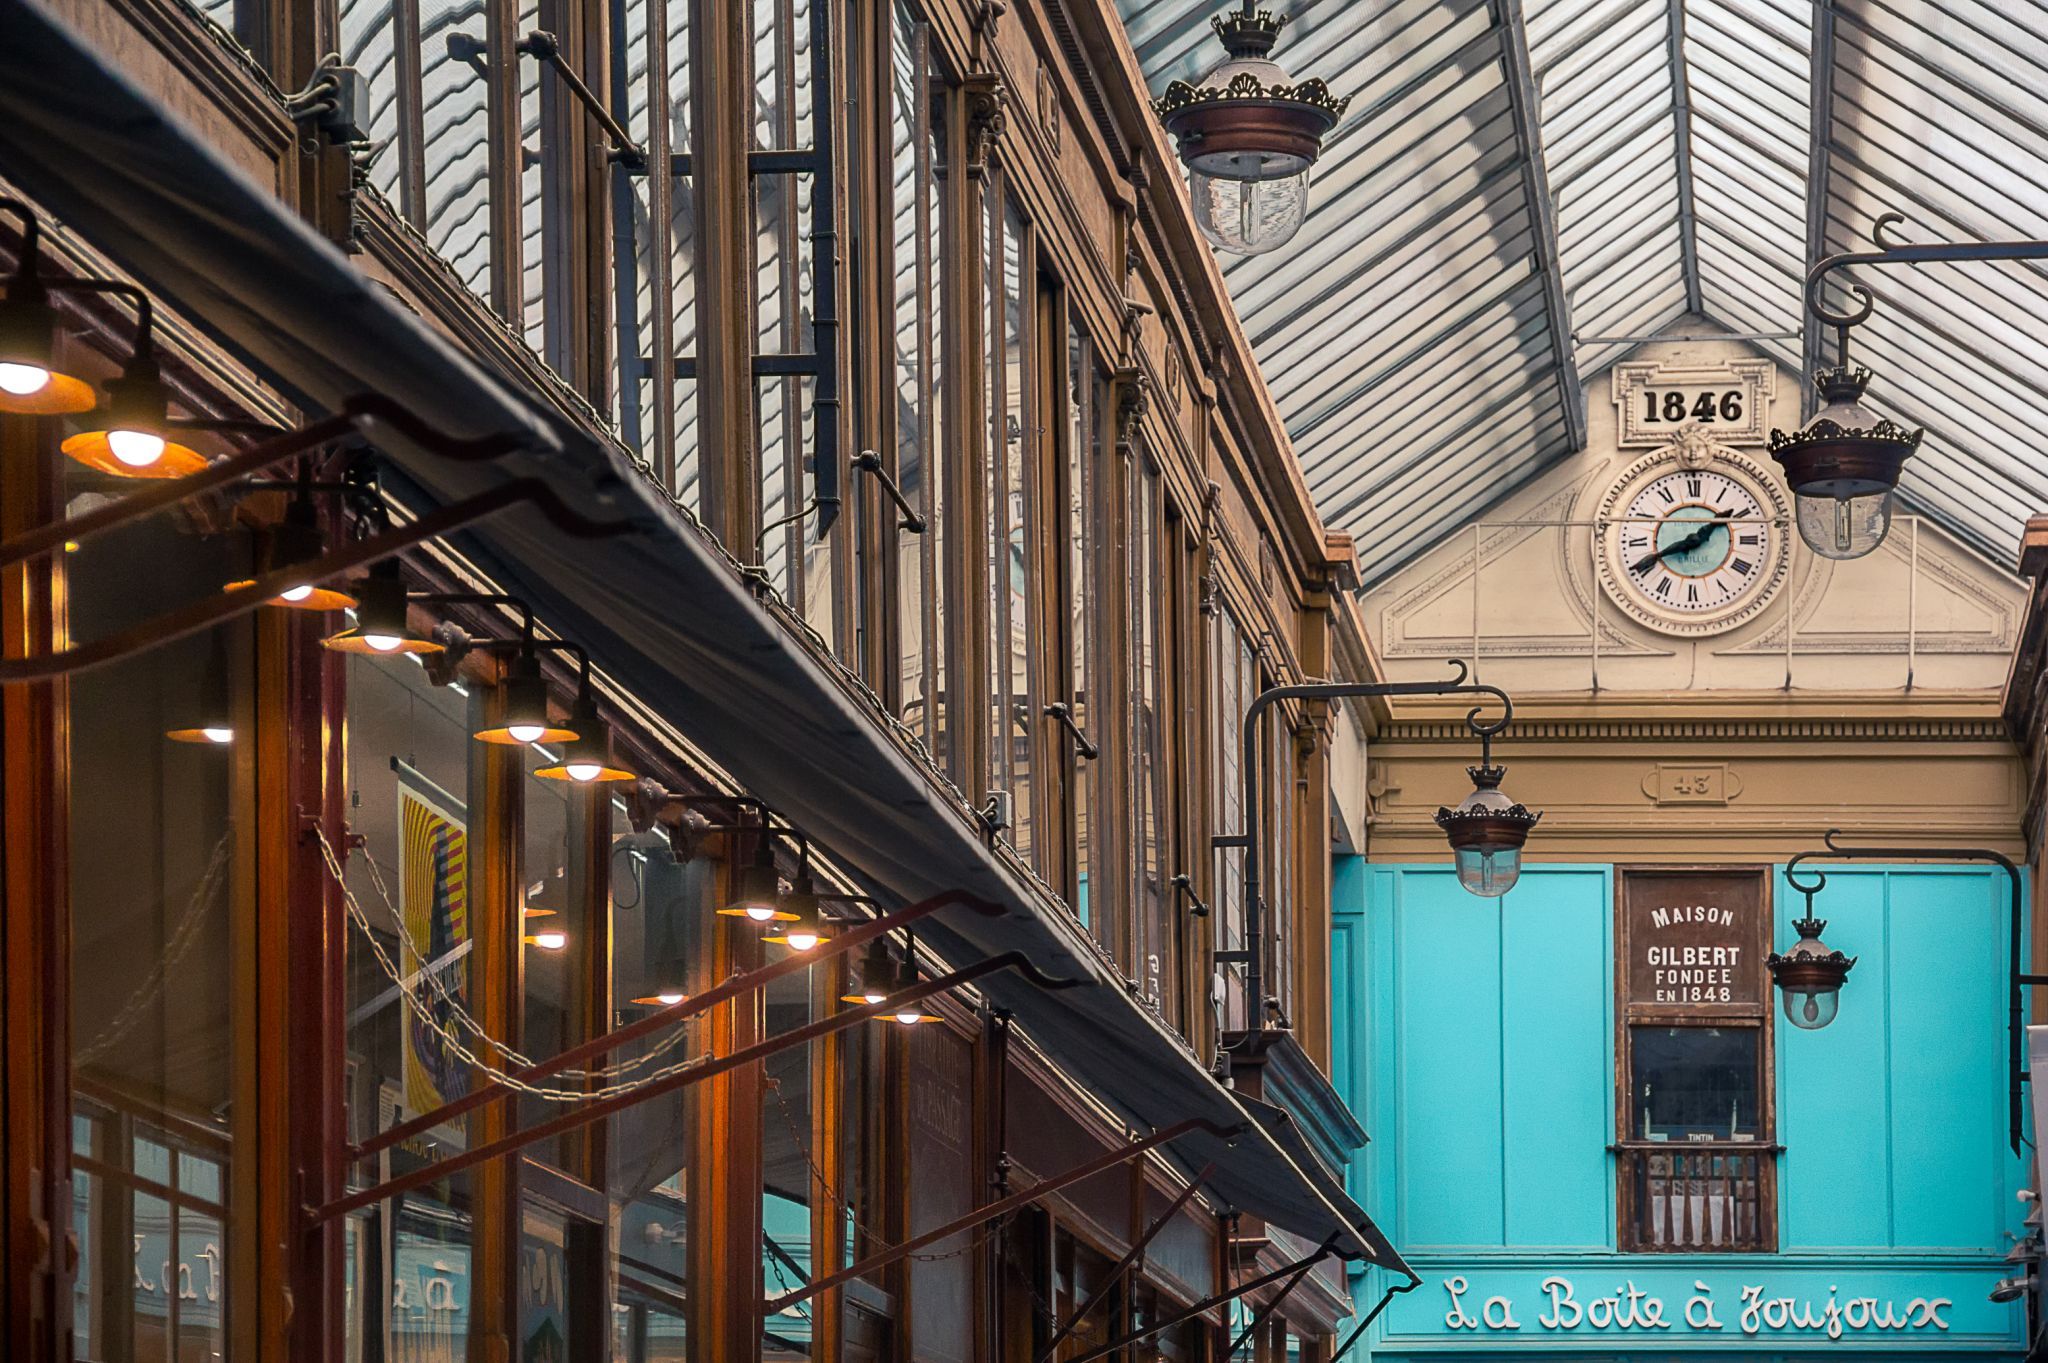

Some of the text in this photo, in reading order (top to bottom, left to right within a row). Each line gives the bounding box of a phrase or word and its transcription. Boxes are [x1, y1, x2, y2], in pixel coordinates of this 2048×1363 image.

[1643, 390, 1744, 422] 1846
[1739, 535, 1759, 546] III
[1651, 906, 1734, 929] MAISON
[1647, 946, 1740, 966] GILBERT
[1655, 968, 1732, 985] FONDEE
[1656, 986, 1731, 1002] EN 1848
[1688, 1133, 1714, 1142] TINTIN
[1444, 1275, 1953, 1339] La Boite à Joujoux
